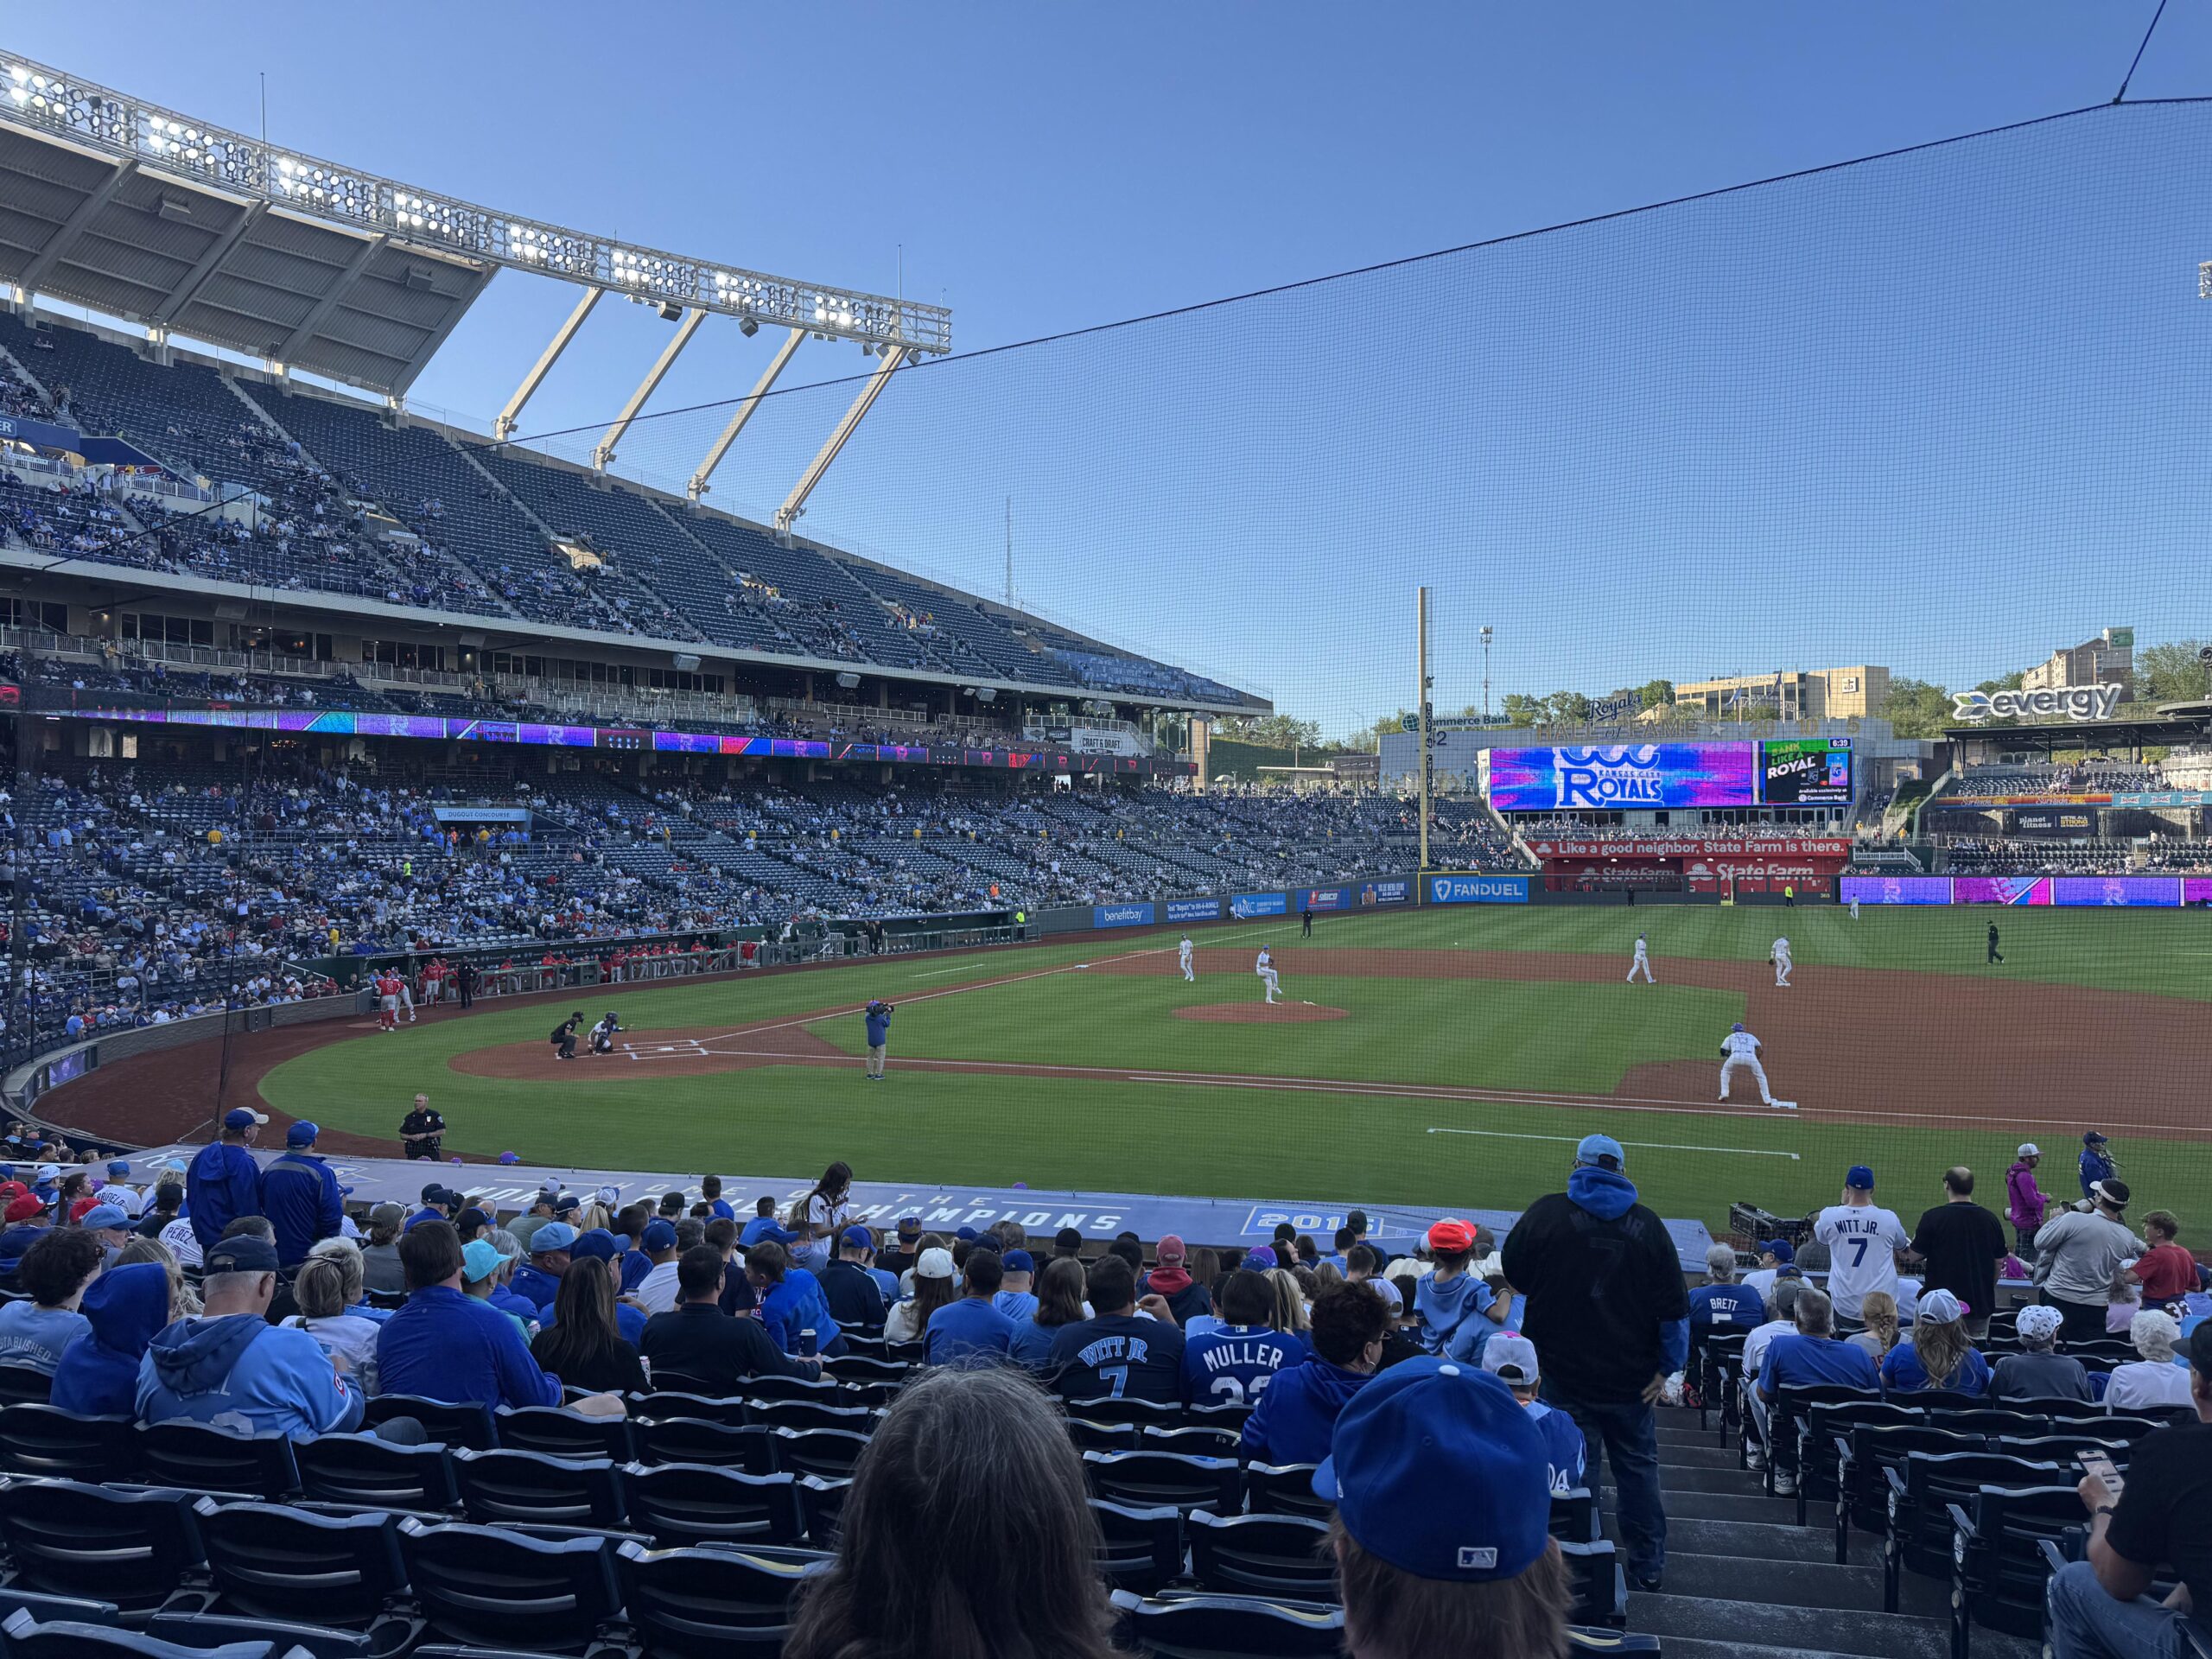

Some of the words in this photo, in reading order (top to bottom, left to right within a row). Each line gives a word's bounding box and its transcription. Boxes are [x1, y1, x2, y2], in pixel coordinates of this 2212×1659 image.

[1587, 692, 1642, 721] Royals
[1993, 686, 2120, 719] evergy
[1432, 716, 1480, 726] ommerce
[1483, 715, 1510, 725] Bank
[1536, 721, 1593, 741] HALL
[1628, 718, 1699, 737] FAME
[1082, 737, 1099, 747] CRAFT
[1104, 739, 1121, 748] DRAFT
[1771, 742, 1800, 757] BANK
[1768, 756, 1815, 779] ROYAL
[1771, 753, 1795, 766] LIKE
[1560, 767, 1662, 806] ROYALS
[1559, 842, 1586, 855] Like
[1590, 845, 1598, 855] a
[1601, 842, 1633, 857] good
[1637, 842, 1700, 857] neighbor,
[1704, 842, 1740, 853] State
[1745, 842, 1783, 853] Farm
[1786, 842, 1797, 853] is
[1801, 841, 1844, 853] there.
[1602, 868, 1638, 880] State
[1640, 868, 1675, 880] Farm
[1716, 863, 1764, 880] State
[1766, 864, 1814, 880] Farm
[1454, 884, 1522, 896] FANDUEL
[1104, 908, 1142, 922] benefitbay
[894, 1193, 992, 1206] THE
[849, 1203, 1122, 1230] HAMPIONS
[165, 1226, 195, 1246] PEREZ
[1835, 1219, 1859, 1236] WITT
[1862, 1220, 1879, 1236] JR.
[1848, 1238, 1867, 1267] 7
[1710, 1298, 1738, 1312] BRETT
[0, 1335, 52, 1362] STABLISHED
[1077, 1336, 1126, 1368] WITT
[1203, 1342, 1284, 1373] MULLER
[1099, 1365, 1128, 1398] 7
